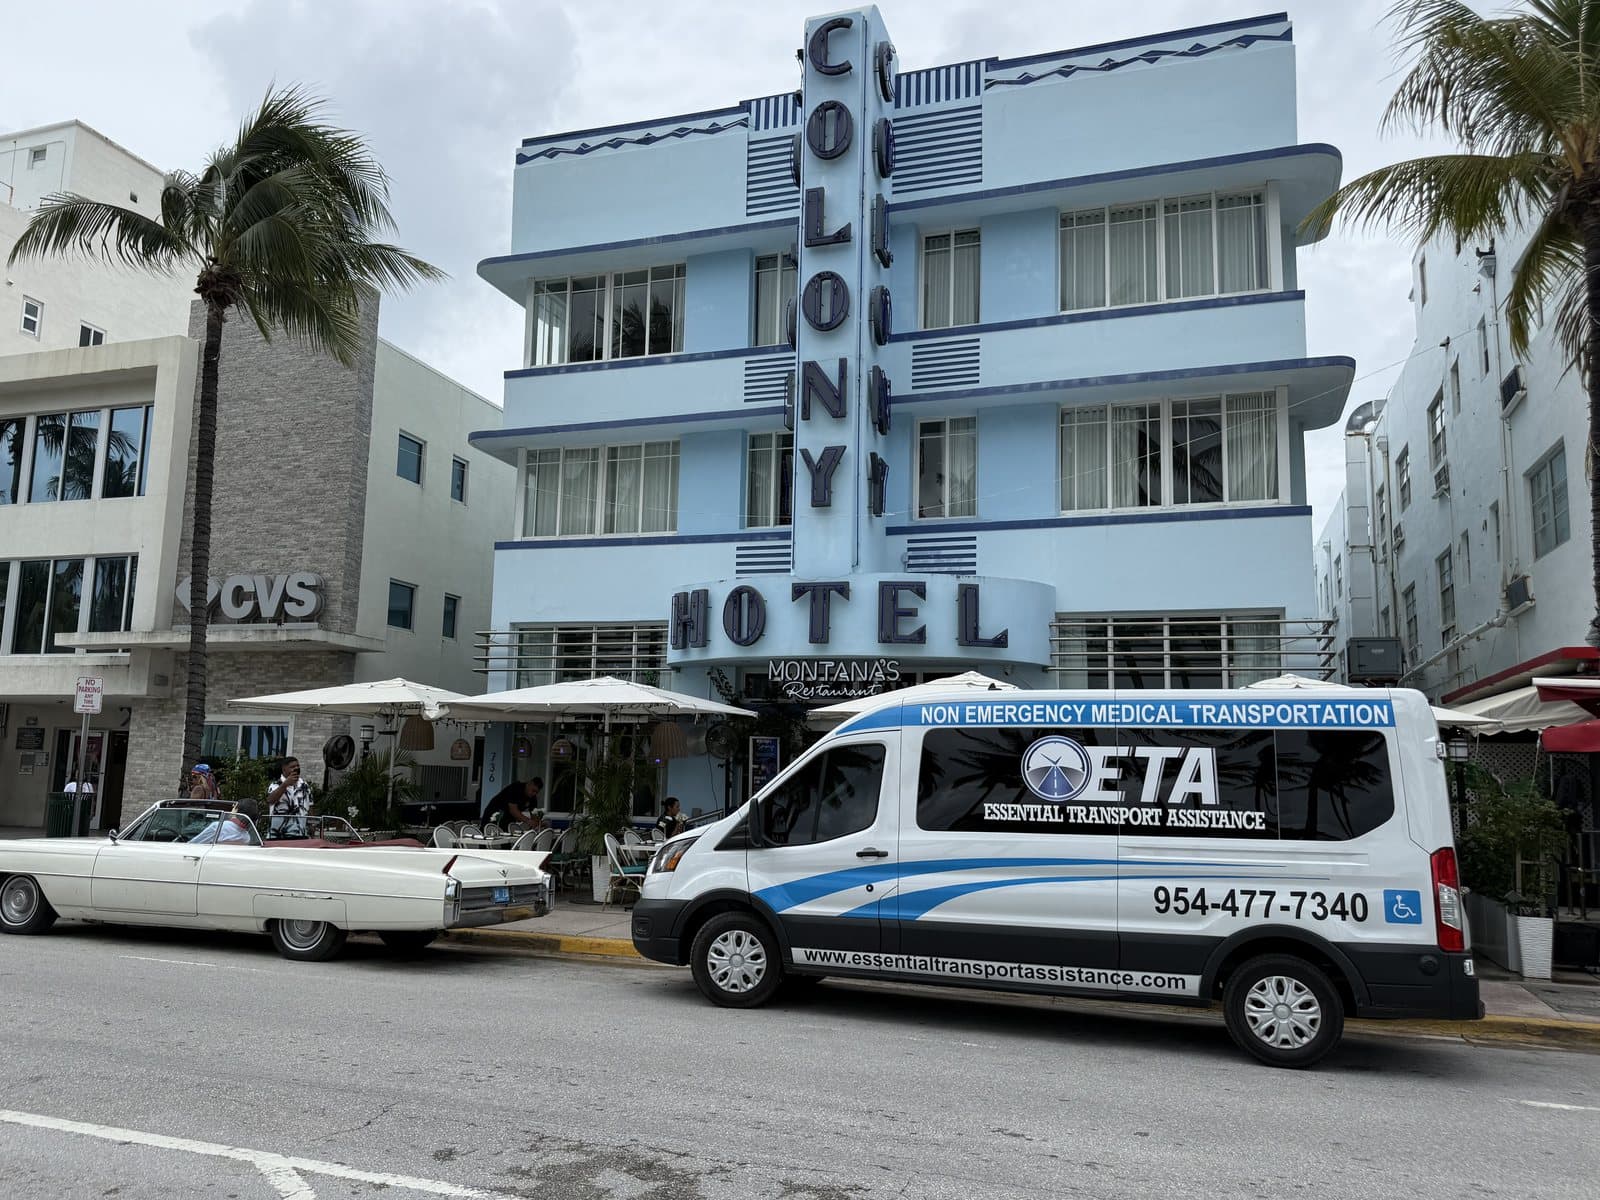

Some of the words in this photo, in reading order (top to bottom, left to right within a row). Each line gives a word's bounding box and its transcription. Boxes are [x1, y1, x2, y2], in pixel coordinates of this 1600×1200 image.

[799, 17, 853, 507] COLONY
[220, 571, 323, 619] CVS
[671, 581, 1009, 650] HOTEL
[768, 658, 900, 682] MONTANA'S
[782, 681, 883, 699] Restaurant
[921, 705, 960, 724] NON
[965, 704, 1086, 723] EMERGENCY
[1091, 704, 1183, 723] MEDICAL
[1189, 704, 1389, 724] TRANSPORTATION
[1074, 745, 1220, 805] ETA
[983, 803, 1064, 823] ESSENTIAL
[1066, 805, 1163, 826] TRANSPORT
[1166, 808, 1266, 830] ASSISTANCE
[1153, 885, 1369, 923] 954-477-7340
[804, 949, 1186, 990] www.essentialtransportassistance.com
